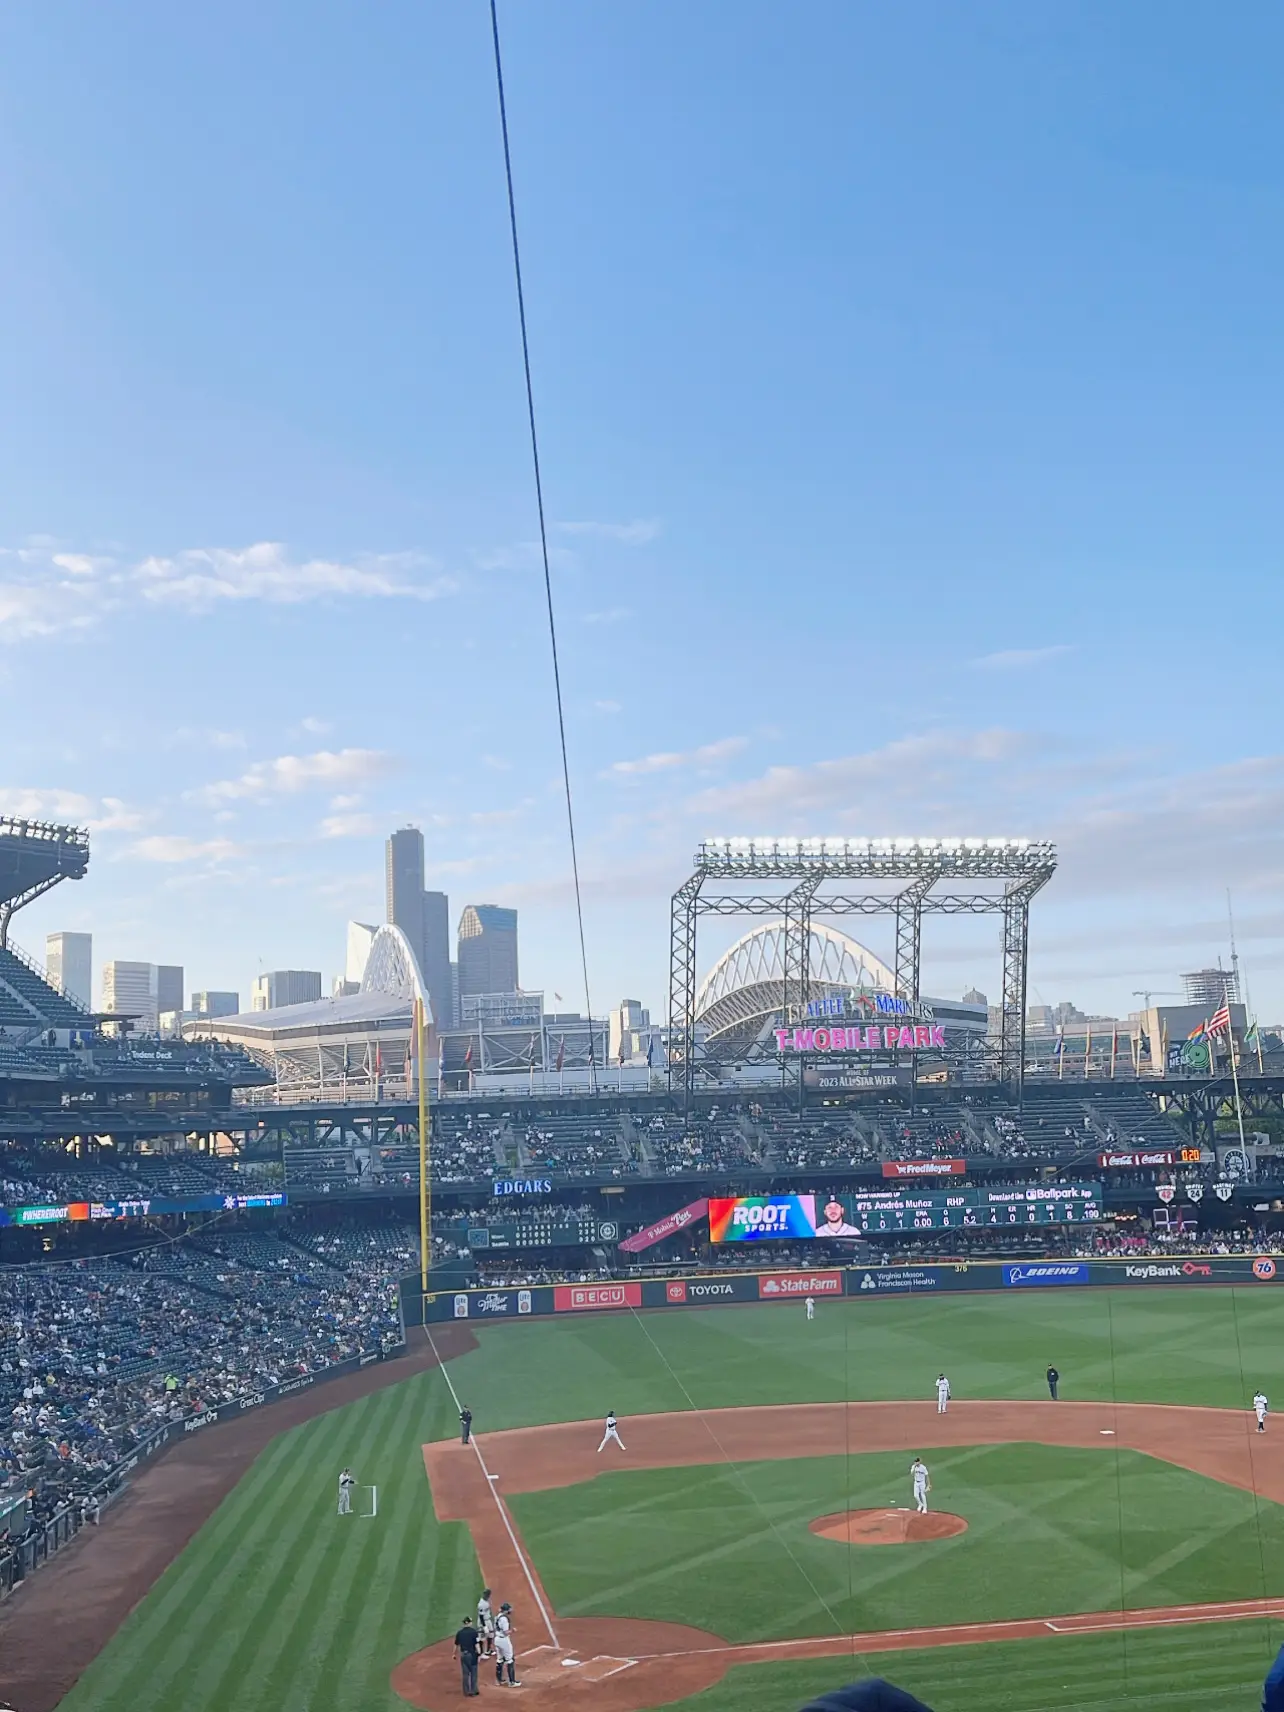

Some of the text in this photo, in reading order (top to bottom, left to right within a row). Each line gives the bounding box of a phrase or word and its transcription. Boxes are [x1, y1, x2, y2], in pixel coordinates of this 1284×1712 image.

[874, 994, 934, 1020] MARINERS
[773, 1026, 946, 1050] T-MOBILE PARK
[156, 1051, 172, 1059] Deck
[819, 1077, 838, 1088] 2023
[875, 1075, 897, 1086] WEEK
[1037, 1187, 1079, 1200] Ballpark
[1161, 1190, 1172, 1198] 42
[857, 1202, 872, 1210] #75
[906, 1200, 932, 1208] Muñoz
[946, 1198, 964, 1206] RHP
[734, 1205, 791, 1225] ROOT
[862, 1221, 868, 1229] 0
[914, 1218, 932, 1227] 0.00
[944, 1217, 949, 1226] 6
[964, 1216, 976, 1225] 5.2
[991, 1215, 996, 1223] 4
[1029, 1213, 1034, 1221] 0
[1067, 1211, 1073, 1219] 8
[1027, 1266, 1079, 1276] BOEING
[1126, 1265, 1181, 1278] KeyBank
[1257, 1262, 1271, 1273] 76
[576, 1289, 621, 1302] BECU
[689, 1285, 733, 1296] TOYOTA
